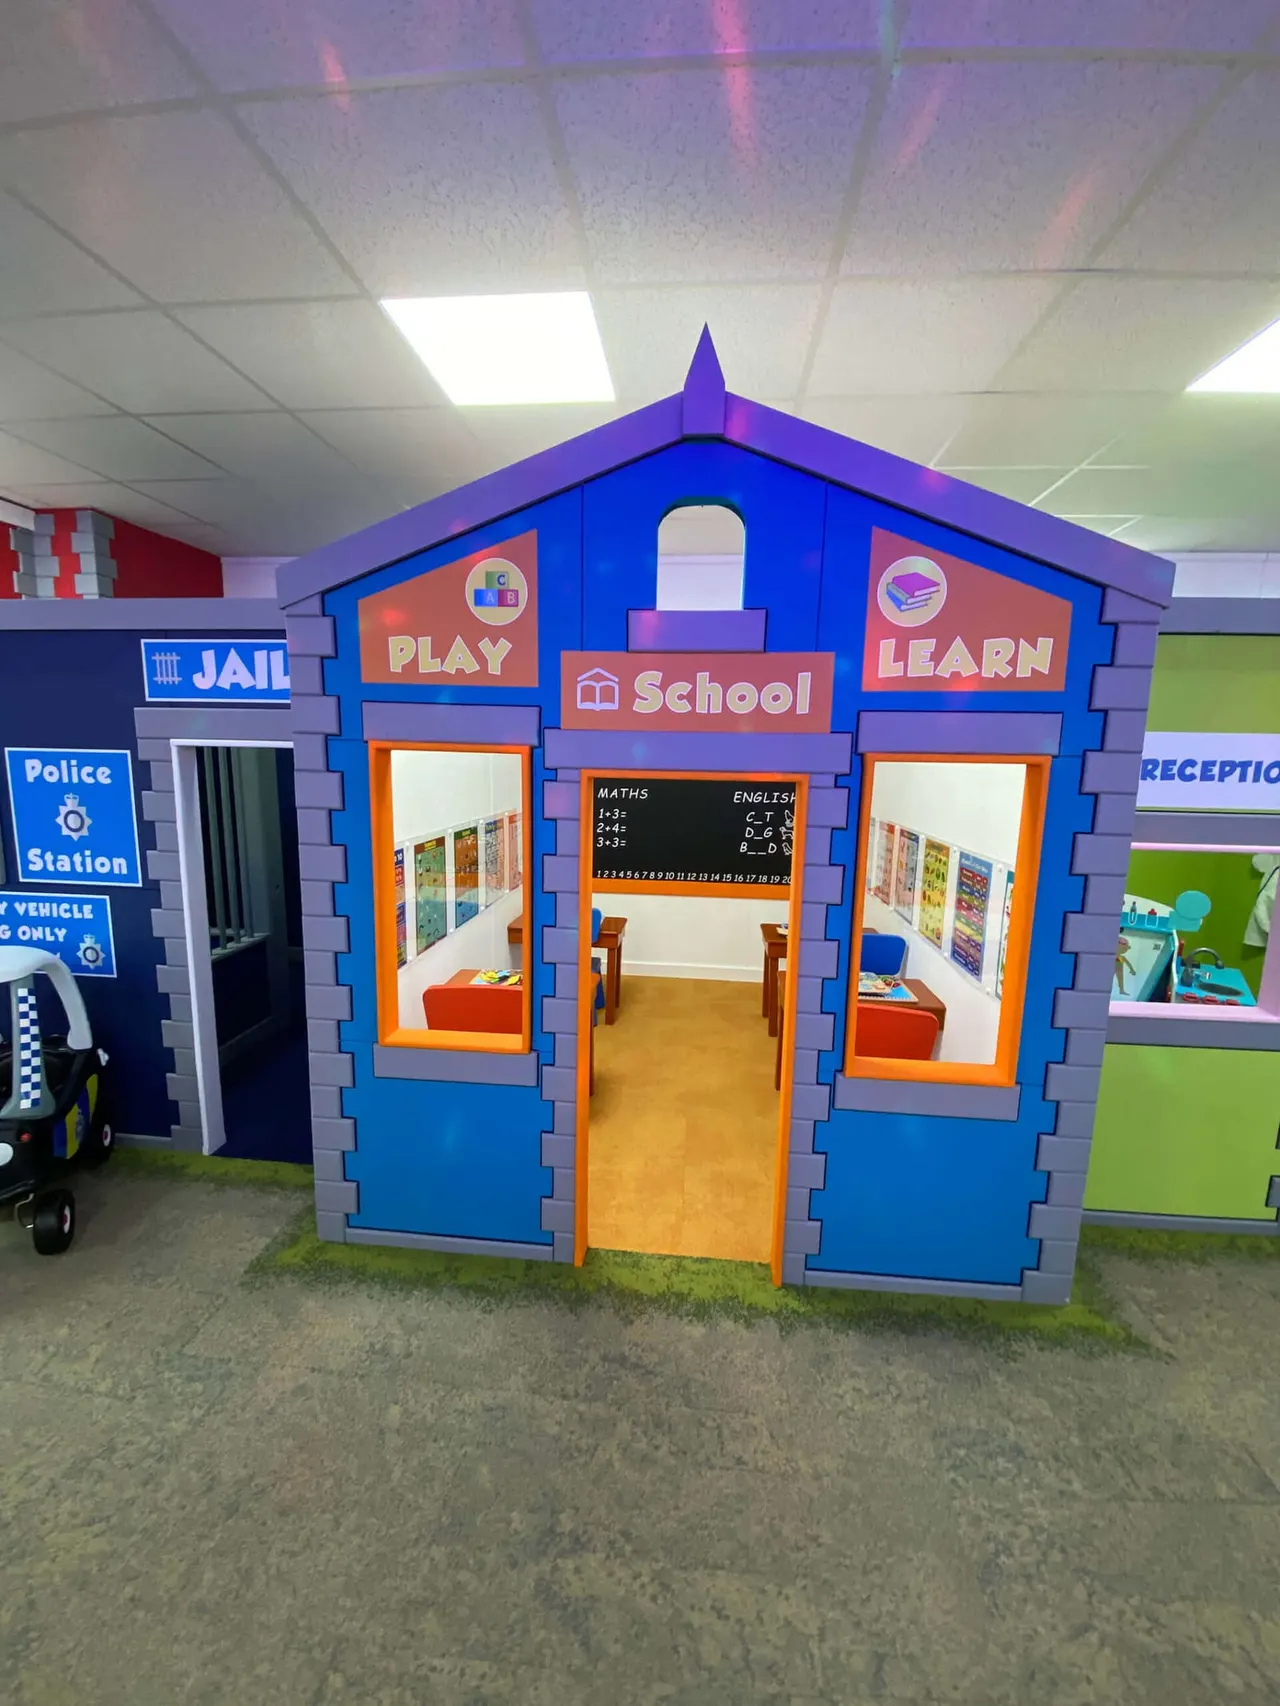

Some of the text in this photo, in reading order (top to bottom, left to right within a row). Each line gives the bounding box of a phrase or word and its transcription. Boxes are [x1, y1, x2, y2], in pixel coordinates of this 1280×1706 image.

[497, 574, 506, 586] C
[387, 634, 512, 676] PLAY
[877, 635, 1054, 679] LEARN
[192, 647, 290, 690] JAIL
[632, 671, 812, 715] School
[24, 758, 113, 784] Police
[597, 787, 649, 799] MATHS
[599, 808, 627, 819] 1+3=
[596, 822, 627, 833] 2+4=
[596, 836, 627, 847] 3+3=
[28, 848, 128, 875] Station
[597, 870, 601, 878] 1
[603, 870, 609, 878] 2
[610, 870, 616, 878] 3
[634, 871, 640, 879] 6
[642, 871, 648, 879] 7
[649, 871, 655, 879] 8
[665, 872, 675, 880] 10
[676, 872, 684, 880] 11
[698, 873, 708, 881] 13
[710, 873, 720, 881] 14
[722, 873, 732, 882] 15
[734, 874, 744, 882] 16
[746, 874, 756, 883] 17
[758, 875, 768, 883] 18
[769, 875, 780, 883] 19
[13, 901, 94, 919] VEHICLE
[17, 925, 67, 942] ONLY
